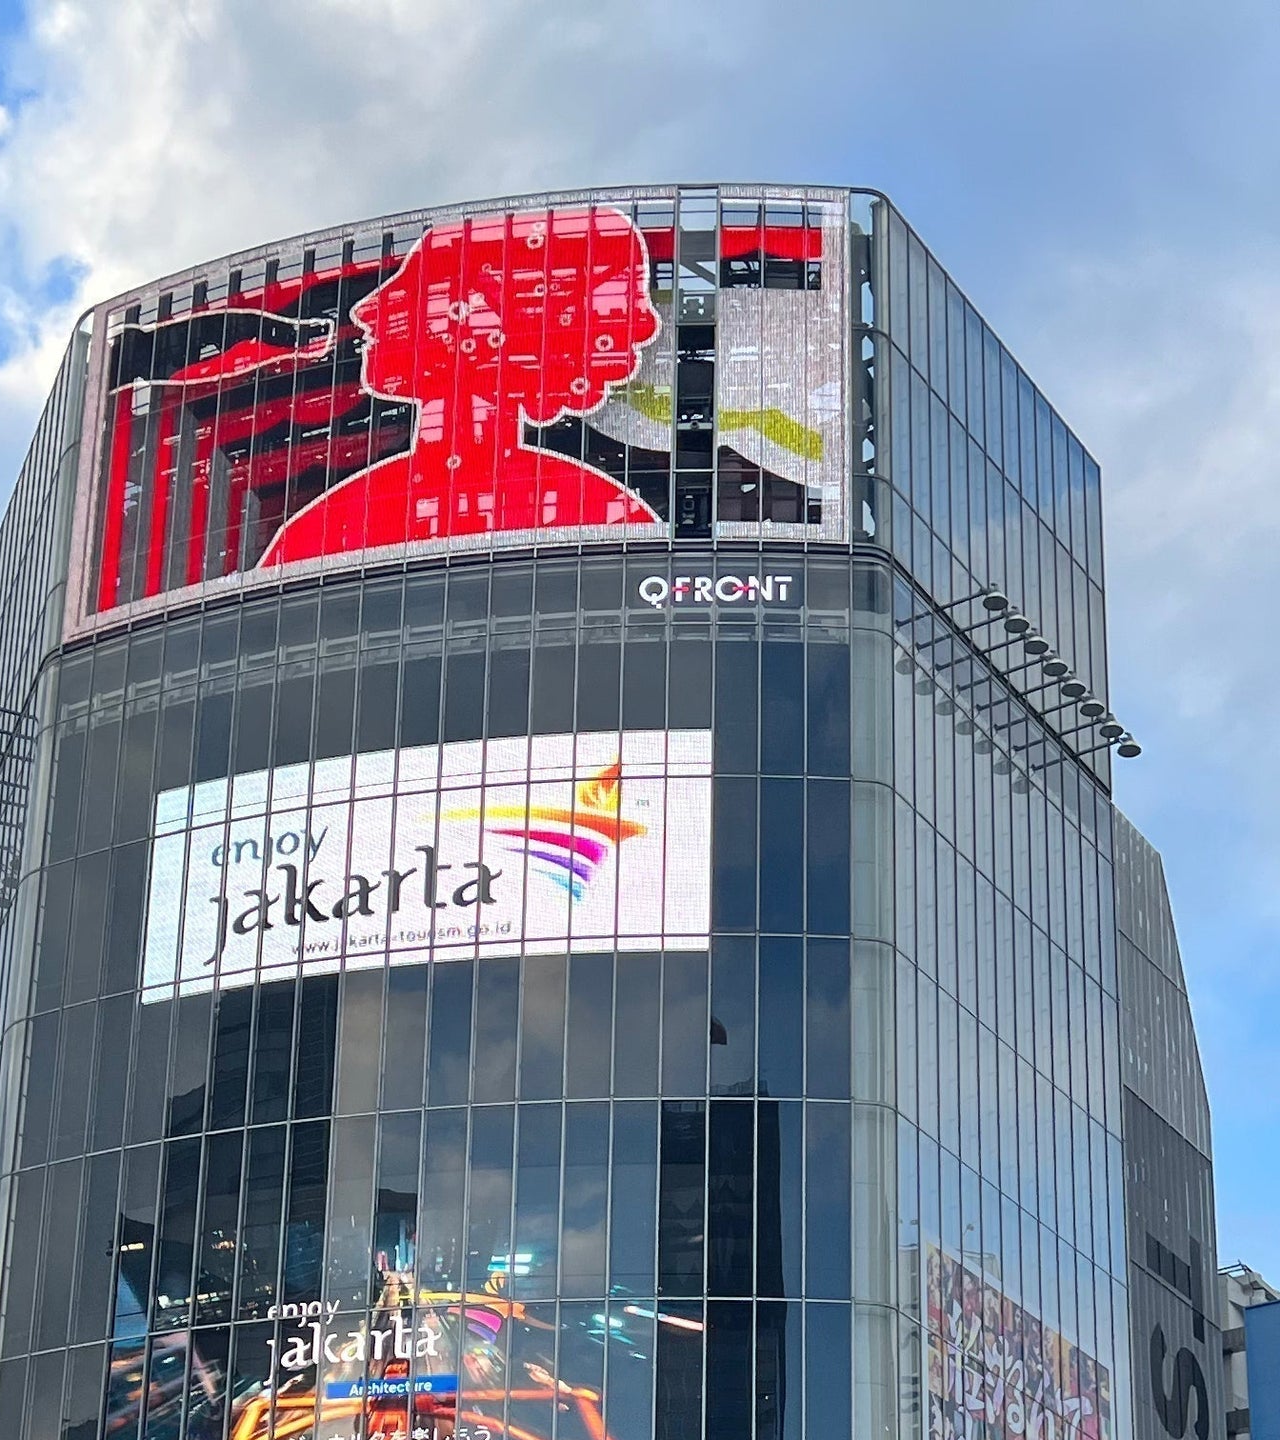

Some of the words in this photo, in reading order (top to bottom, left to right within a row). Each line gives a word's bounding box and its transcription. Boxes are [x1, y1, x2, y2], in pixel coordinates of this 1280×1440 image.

[639, 575, 792, 608] QFRONT
[212, 825, 328, 872] enjoy
[203, 846, 502, 966] jakarta
[267, 1299, 341, 1327] enjoy
[263, 1315, 442, 1386] jakarta
